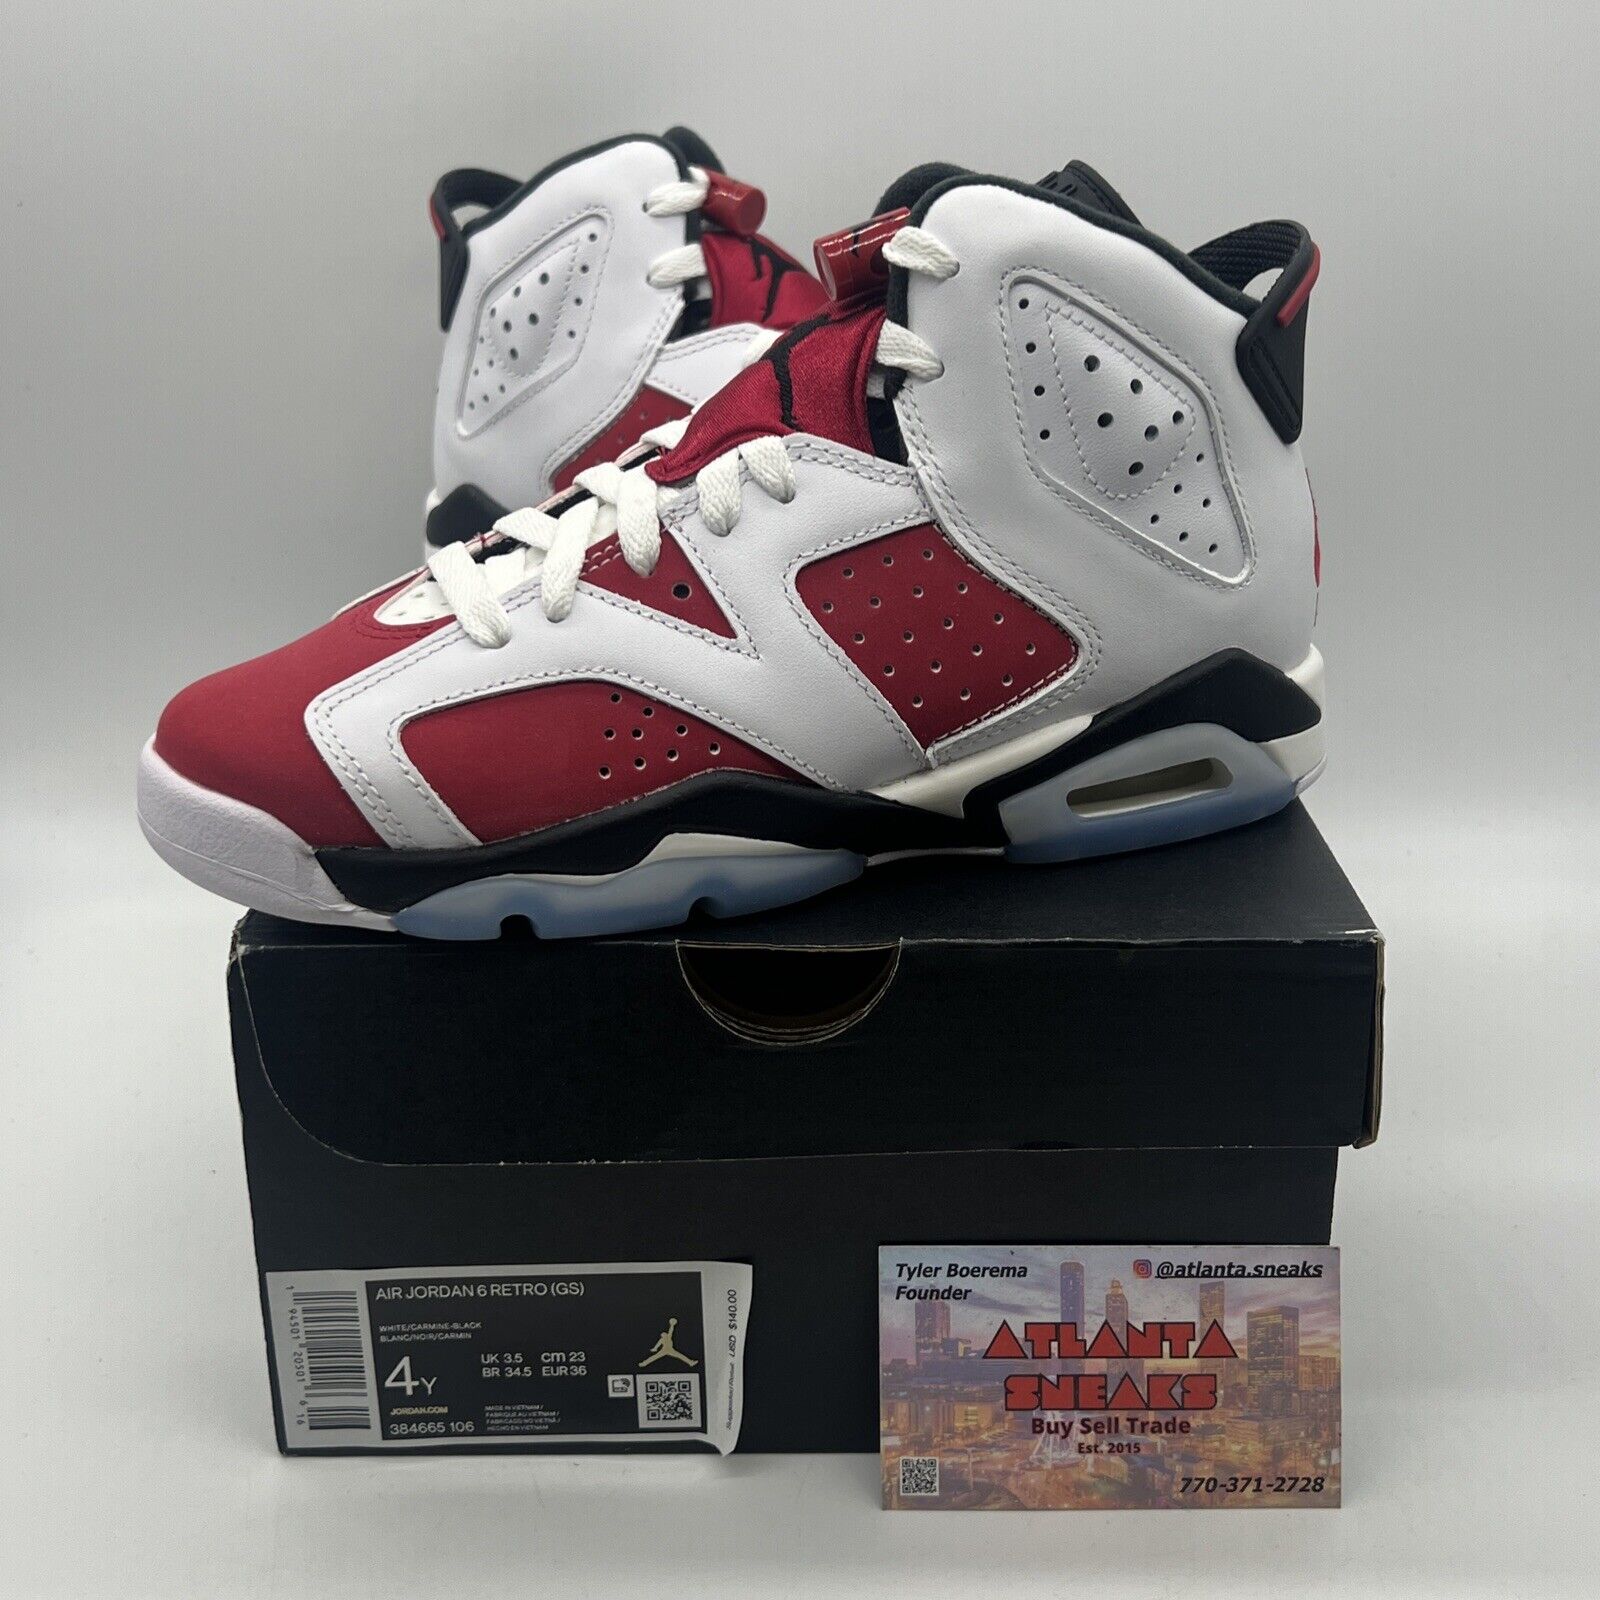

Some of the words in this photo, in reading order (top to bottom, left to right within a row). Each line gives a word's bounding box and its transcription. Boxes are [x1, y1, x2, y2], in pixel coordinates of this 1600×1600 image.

[896, 1263, 942, 1281] Tyler
[946, 1263, 1028, 1278] Boerema
[1155, 1261, 1323, 1279] @atlanta.sneaks
[376, 1287, 402, 1300] AIR
[405, 1285, 474, 1299] JORDAN
[477, 1284, 487, 1297] 6
[490, 1283, 547, 1297] RETRO
[551, 1282, 585, 1297] (GS)
[895, 1285, 972, 1301] Founder
[727, 1289, 738, 1330] $140.00
[379, 1322, 482, 1332] WHITE/CARMINE-BLACK
[380, 1332, 472, 1343] BLANC/NOIR/CARMIN
[728, 1335, 737, 1357] USD
[982, 1318, 1239, 1359] ATLANTA
[481, 1354, 500, 1365] UK
[503, 1353, 523, 1364] 3.5
[569, 1351, 586, 1363] 23
[293, 1351, 306, 1383] 20501
[482, 1367, 501, 1378] BR
[505, 1366, 532, 1377] 34.5
[542, 1365, 569, 1377] EUR
[570, 1365, 587, 1376] 36
[1003, 1371, 1218, 1411] SNEAKS
[390, 1406, 448, 1416] JORDAN.COM
[390, 1422, 446, 1435] 384665
[450, 1421, 475, 1433] 106
[1032, 1417, 1074, 1439] Buy
[1080, 1416, 1120, 1434] Sell
[1126, 1417, 1191, 1434] Trade
[1078, 1442, 1103, 1454] Est.
[1107, 1442, 1141, 1454] 2015
[1179, 1476, 1325, 1493] 770-371-2728
